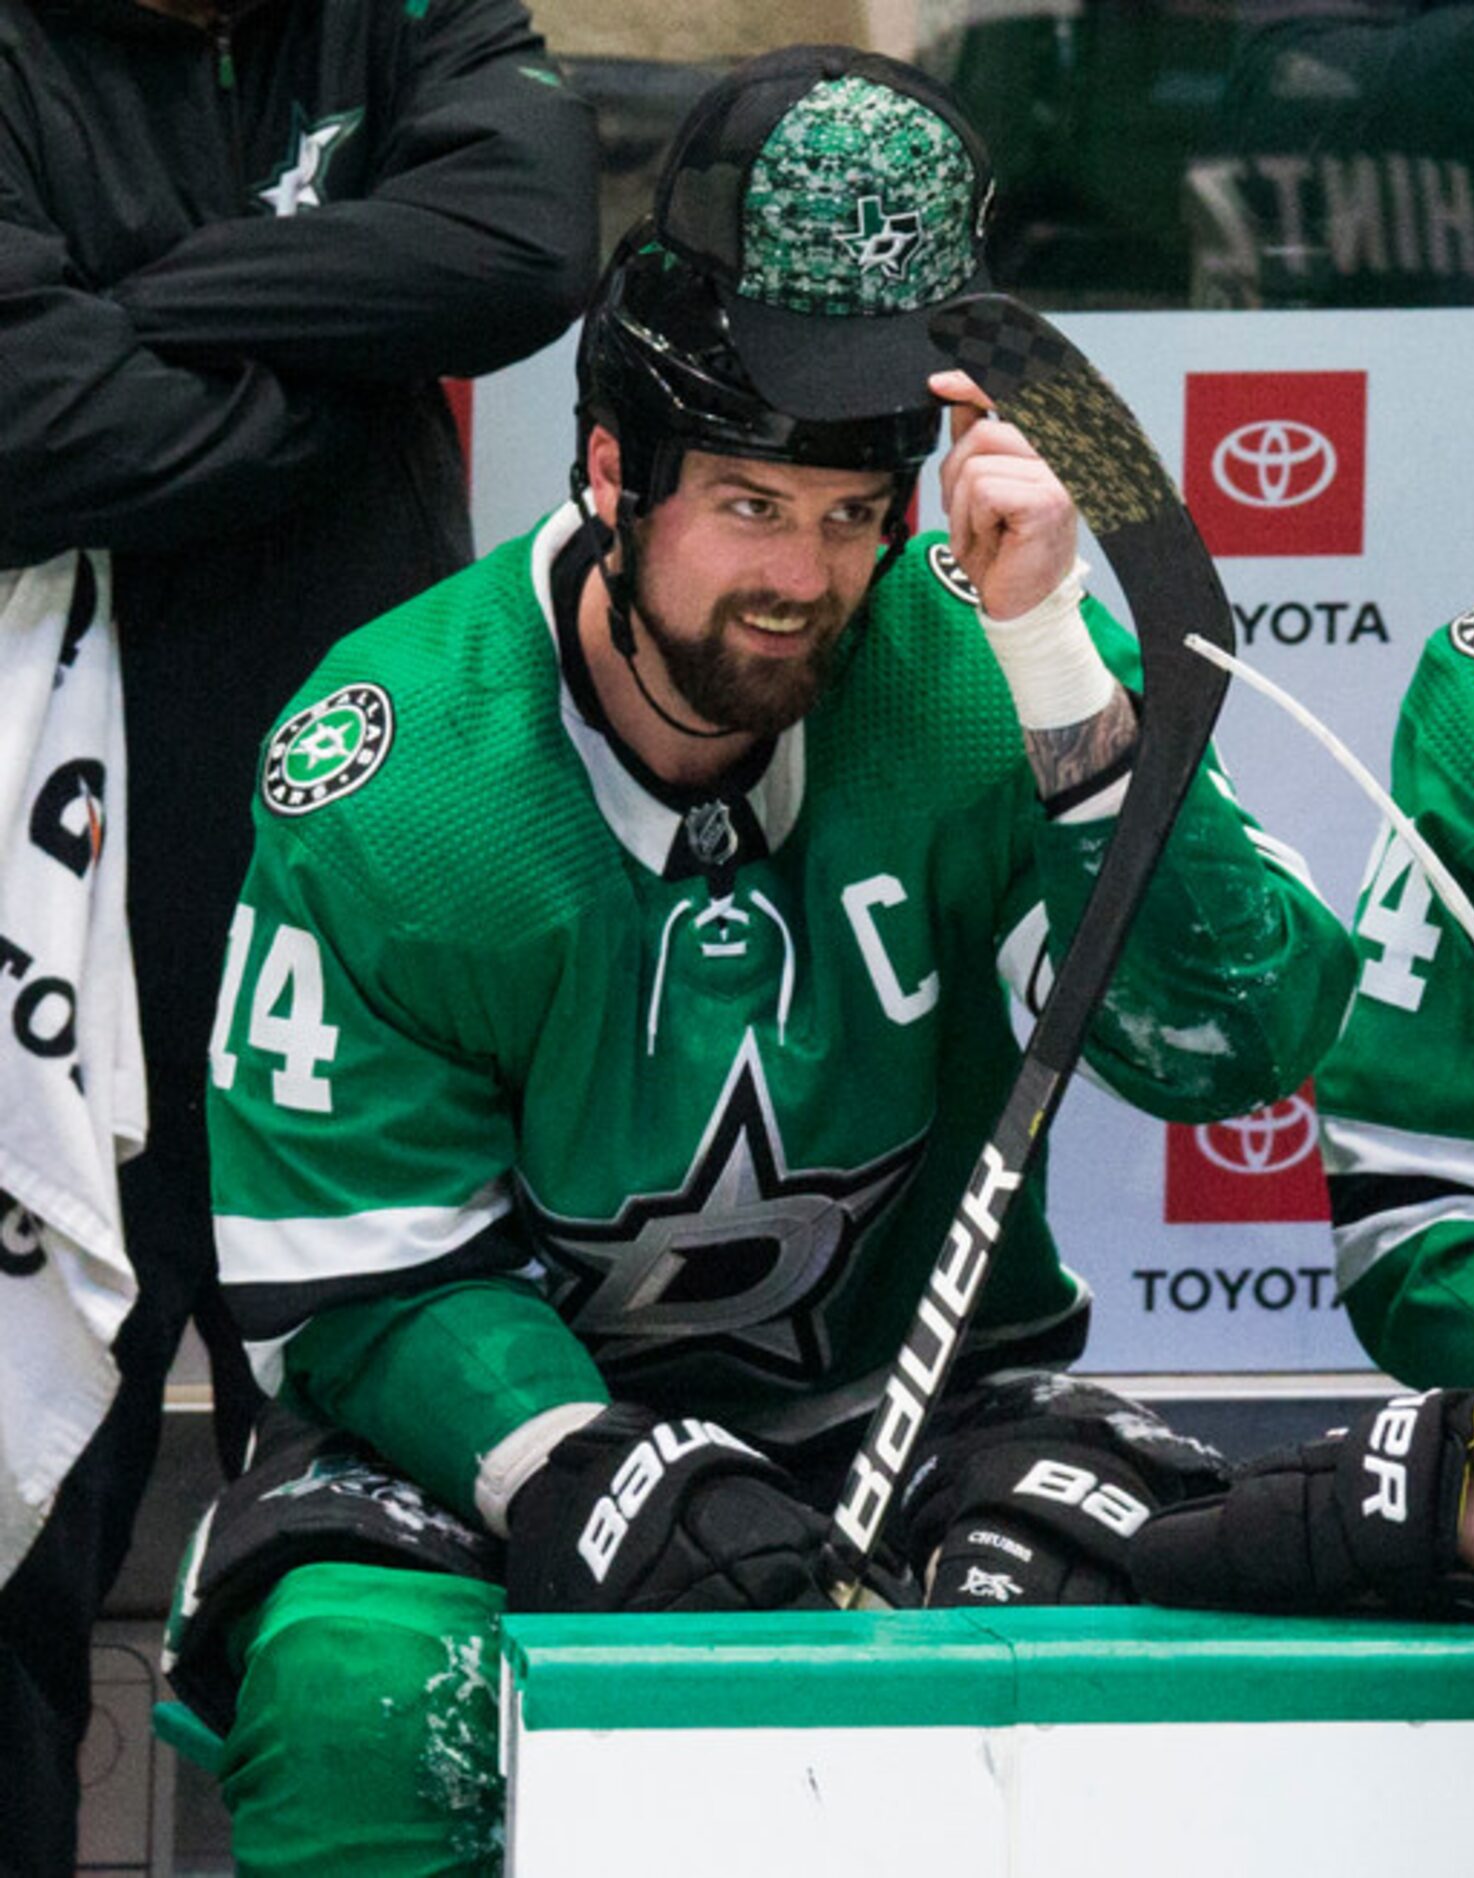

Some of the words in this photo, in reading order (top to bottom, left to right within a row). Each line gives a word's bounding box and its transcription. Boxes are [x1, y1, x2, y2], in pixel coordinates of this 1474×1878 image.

[208, 902, 341, 1114] 14
[840, 872, 941, 1027] C
[1132, 1267, 1343, 1312] TOYOT
